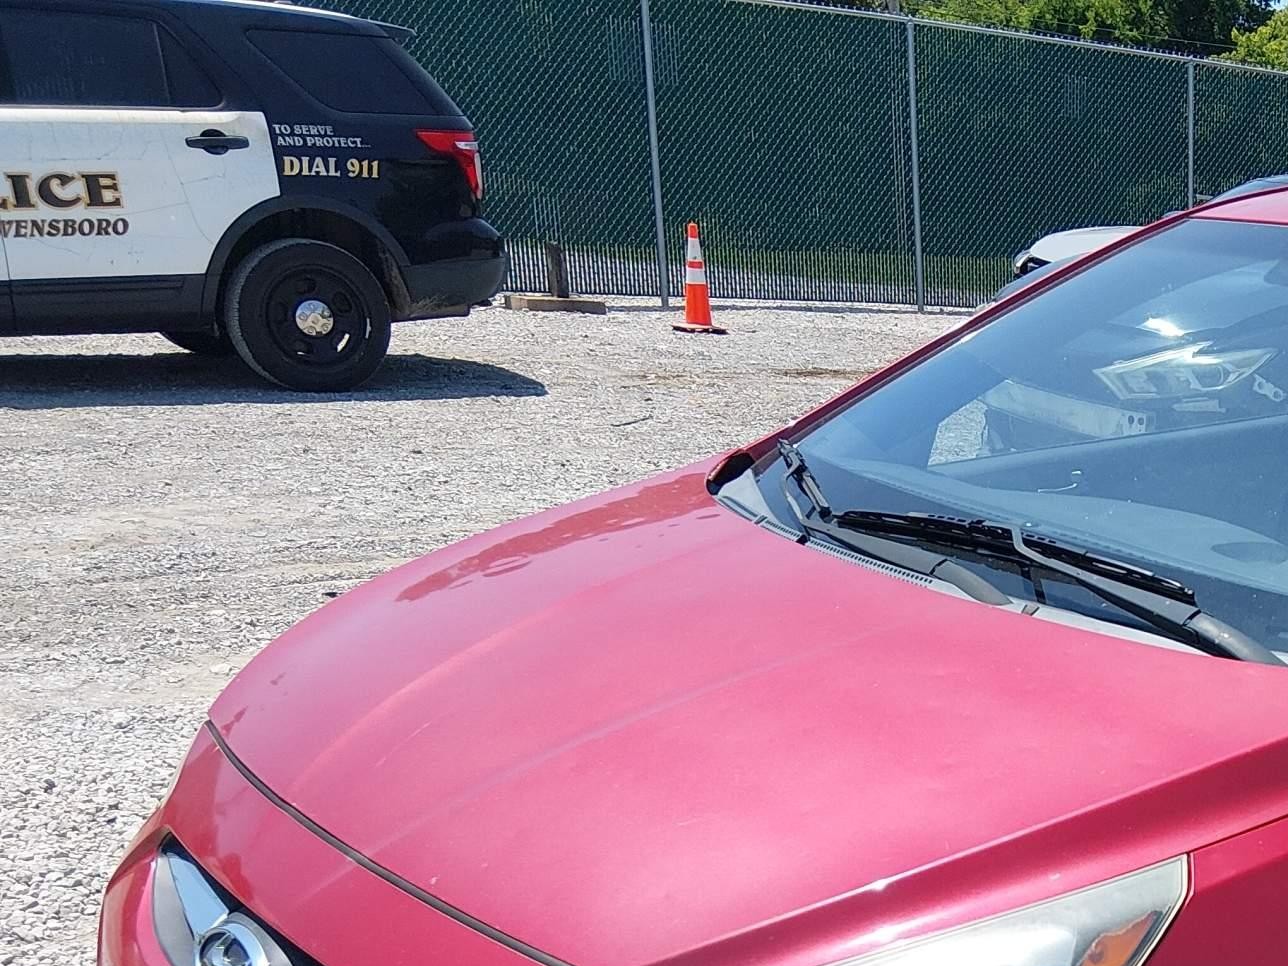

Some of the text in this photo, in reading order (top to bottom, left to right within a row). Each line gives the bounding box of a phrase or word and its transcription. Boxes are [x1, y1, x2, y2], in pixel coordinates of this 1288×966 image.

[272, 124, 334, 135] TO SERVE
[277, 136, 304, 147] AND
[282, 156, 380, 178] DIAL 911
